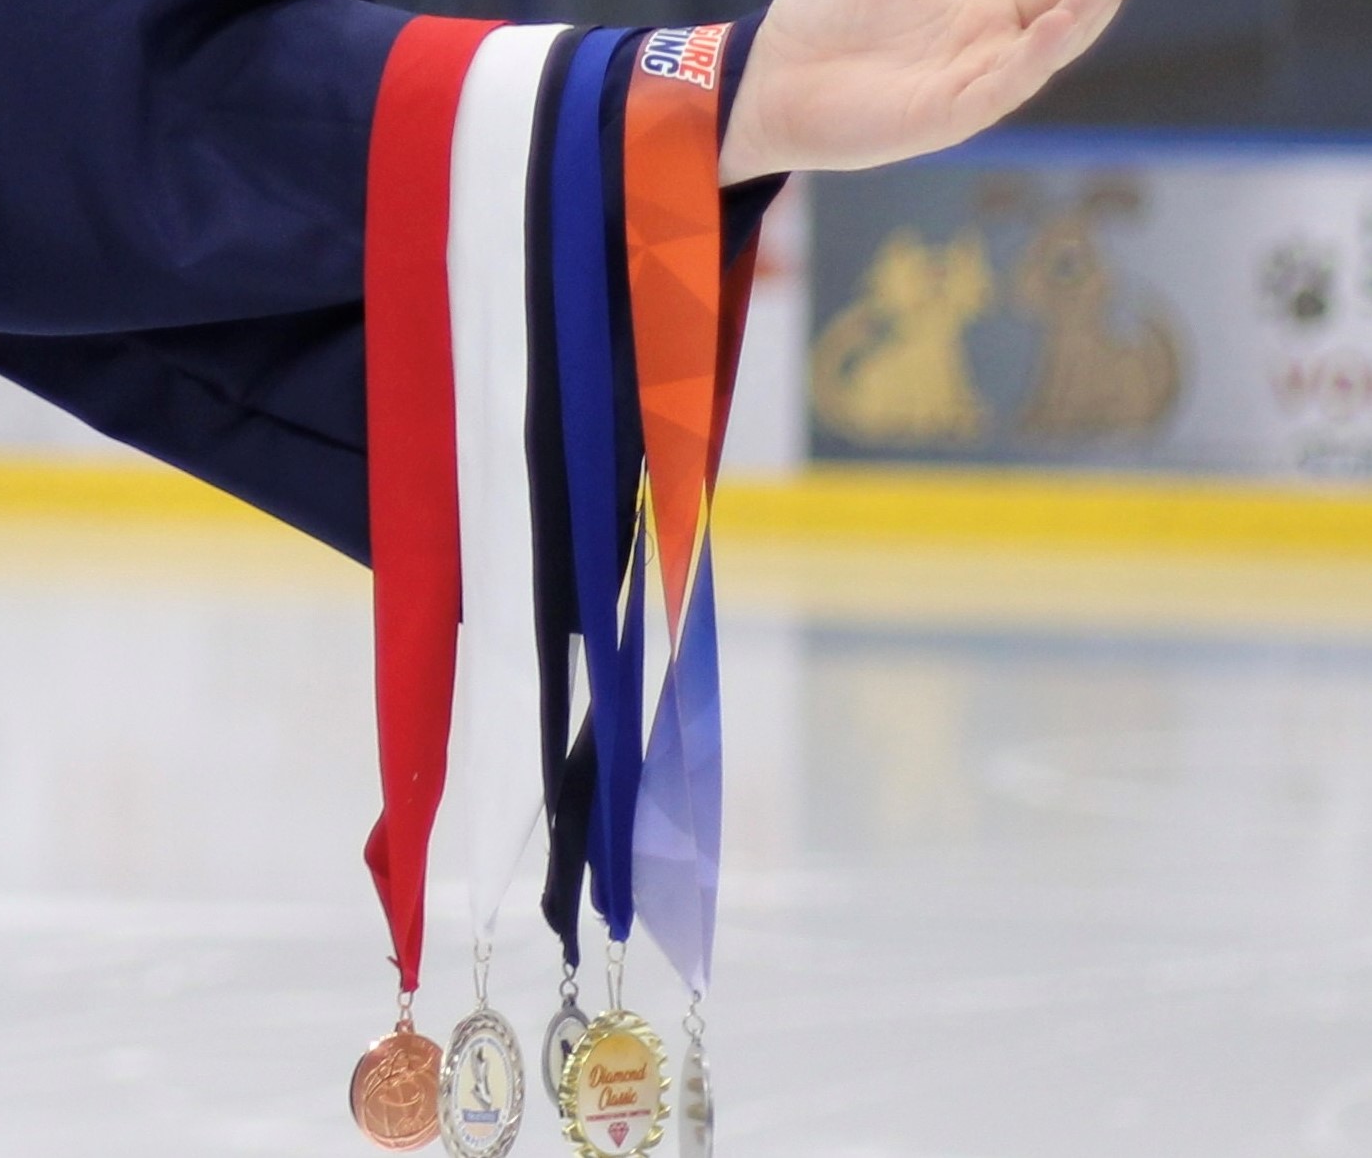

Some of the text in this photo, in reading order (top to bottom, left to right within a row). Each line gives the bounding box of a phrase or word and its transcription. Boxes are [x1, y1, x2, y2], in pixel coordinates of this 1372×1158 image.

[643, 29, 691, 75] ING
[678, 25, 723, 88] GURE
[589, 1062, 647, 1088] Diamond
[599, 1086, 637, 1110] Classic
